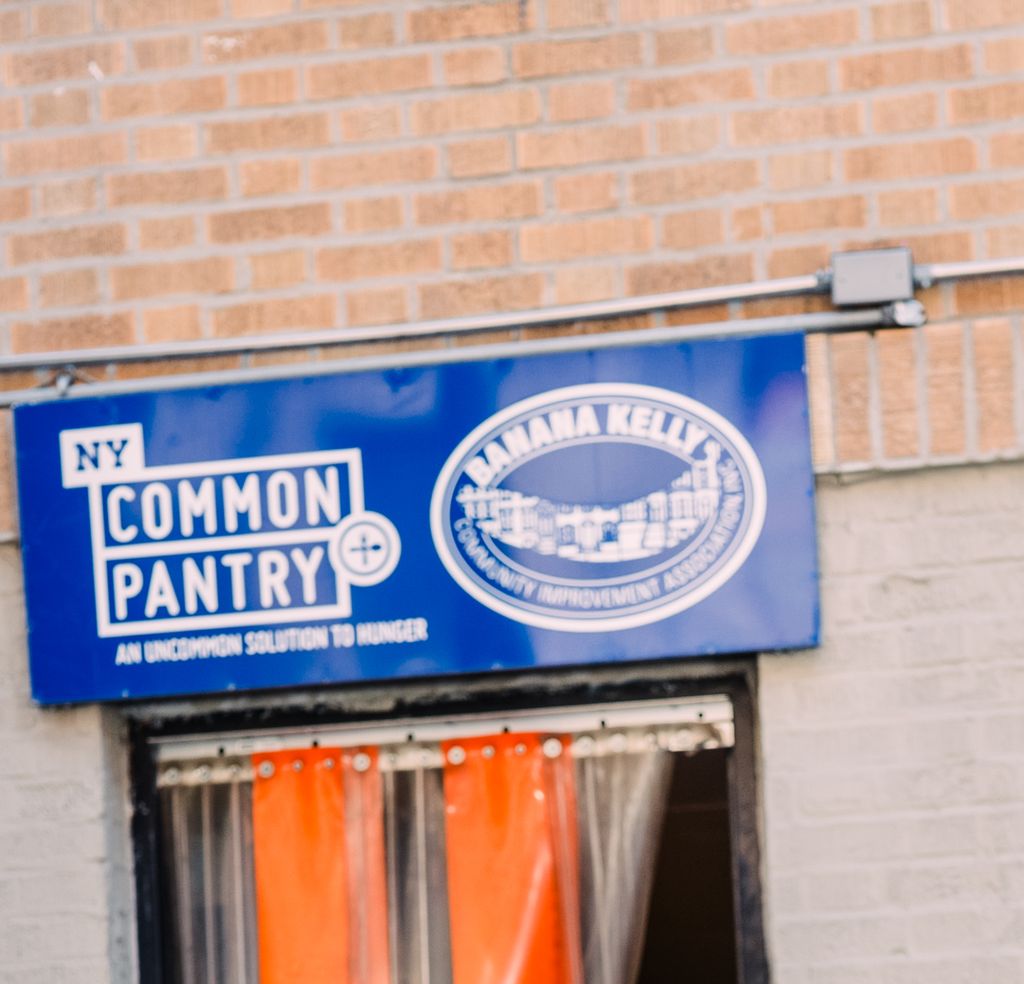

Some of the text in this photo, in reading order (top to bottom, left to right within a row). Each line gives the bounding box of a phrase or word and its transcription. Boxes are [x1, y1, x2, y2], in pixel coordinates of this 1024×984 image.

[75, 440, 129, 471] NY
[463, 404, 600, 490] BANANA
[107, 466, 341, 543] COMMON
[113, 546, 325, 621] PANTRY
[115, 617, 429, 665] AN UNCOMMON SOLUTION TO HUNGER
